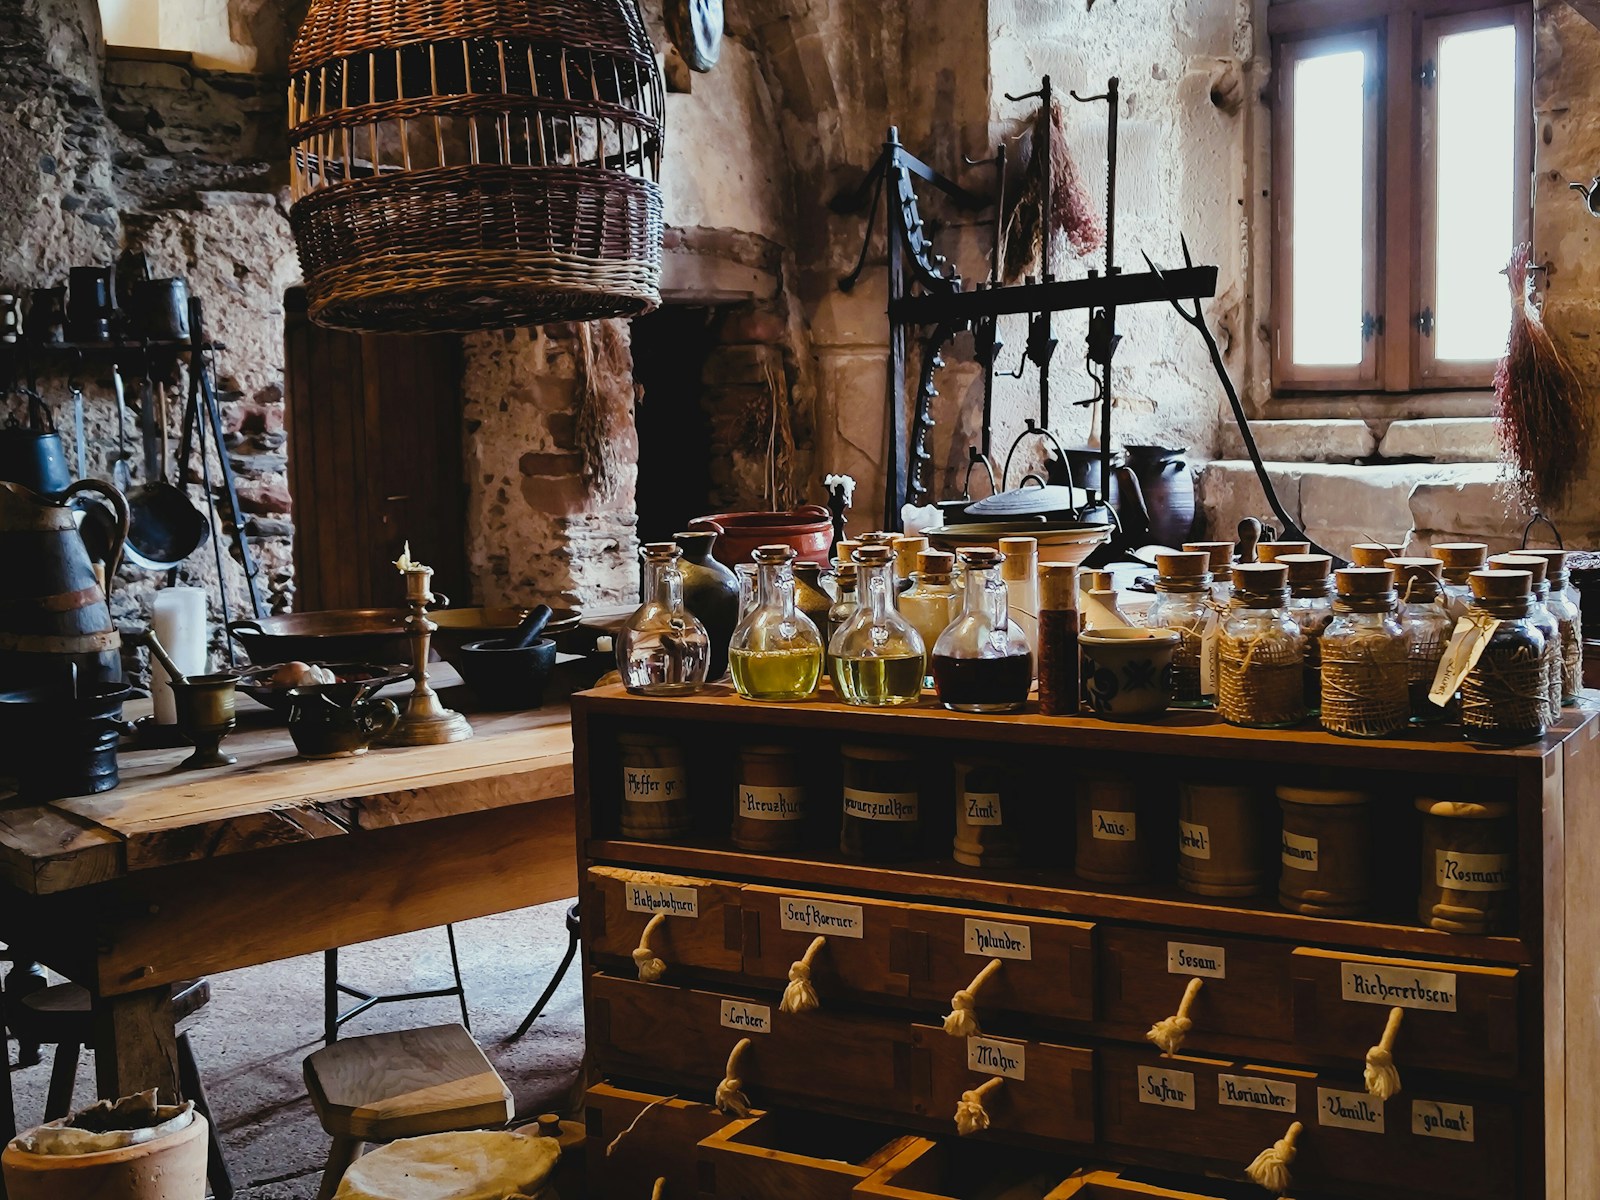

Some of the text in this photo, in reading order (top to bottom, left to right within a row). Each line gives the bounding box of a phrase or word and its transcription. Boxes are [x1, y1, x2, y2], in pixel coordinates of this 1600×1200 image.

[628, 773, 660, 795] Pfeffer
[968, 799, 993, 818] Zimt
[1098, 815, 1125, 836] Anis
[1179, 949, 1217, 971] Sesam
[729, 1007, 764, 1028] Lorbeer
[977, 1045, 1016, 1072] Mohn
[1147, 1075, 1184, 1103] Safran
[1327, 1096, 1376, 1123] Vanille
